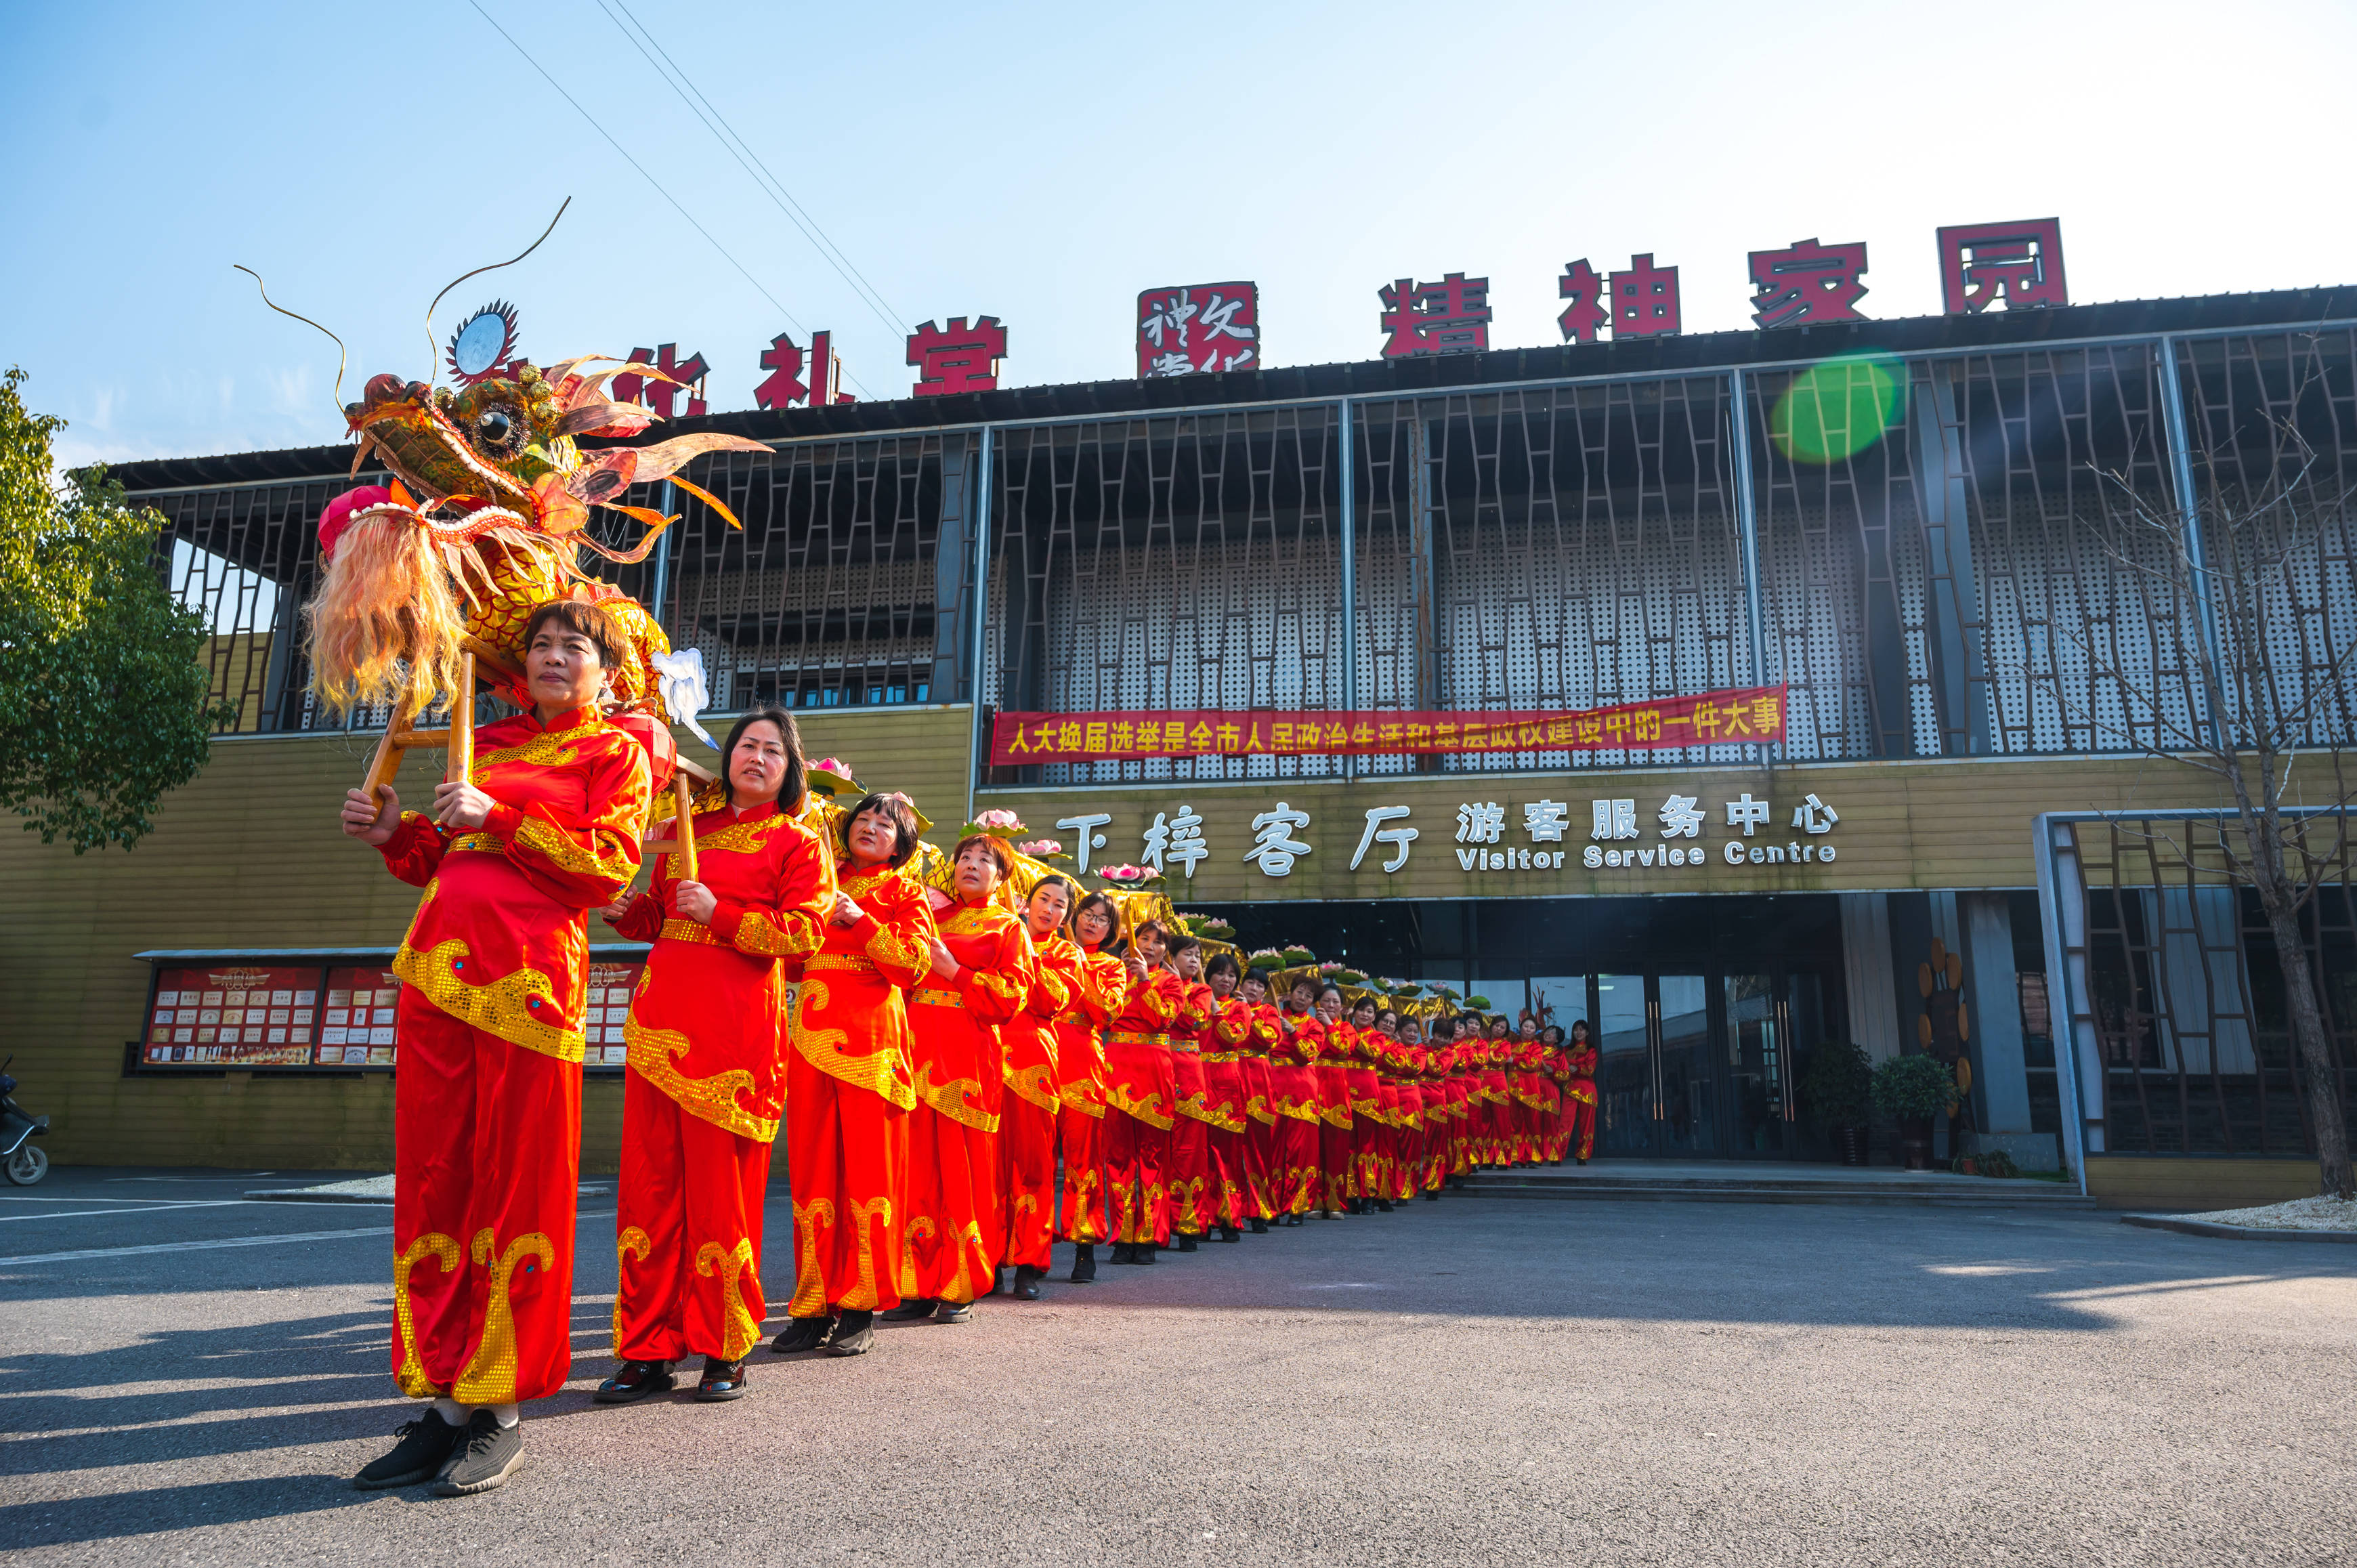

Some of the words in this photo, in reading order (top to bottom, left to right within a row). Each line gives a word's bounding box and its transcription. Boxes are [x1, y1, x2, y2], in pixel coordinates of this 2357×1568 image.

[1379, 216, 2068, 359] 精神家园
[505, 315, 1008, 419] 化礼堂
[1007, 696, 1781, 754] 人大换届选举是全市人民政治生活和基层政权建设中的一件大事
[1055, 801, 1420, 878] 下梓客厅
[1455, 793, 1840, 844] 游客服务中心
[1456, 847, 1565, 871] Visitor
[1583, 843, 1705, 869] Service
[1724, 841, 1836, 864] Centre
